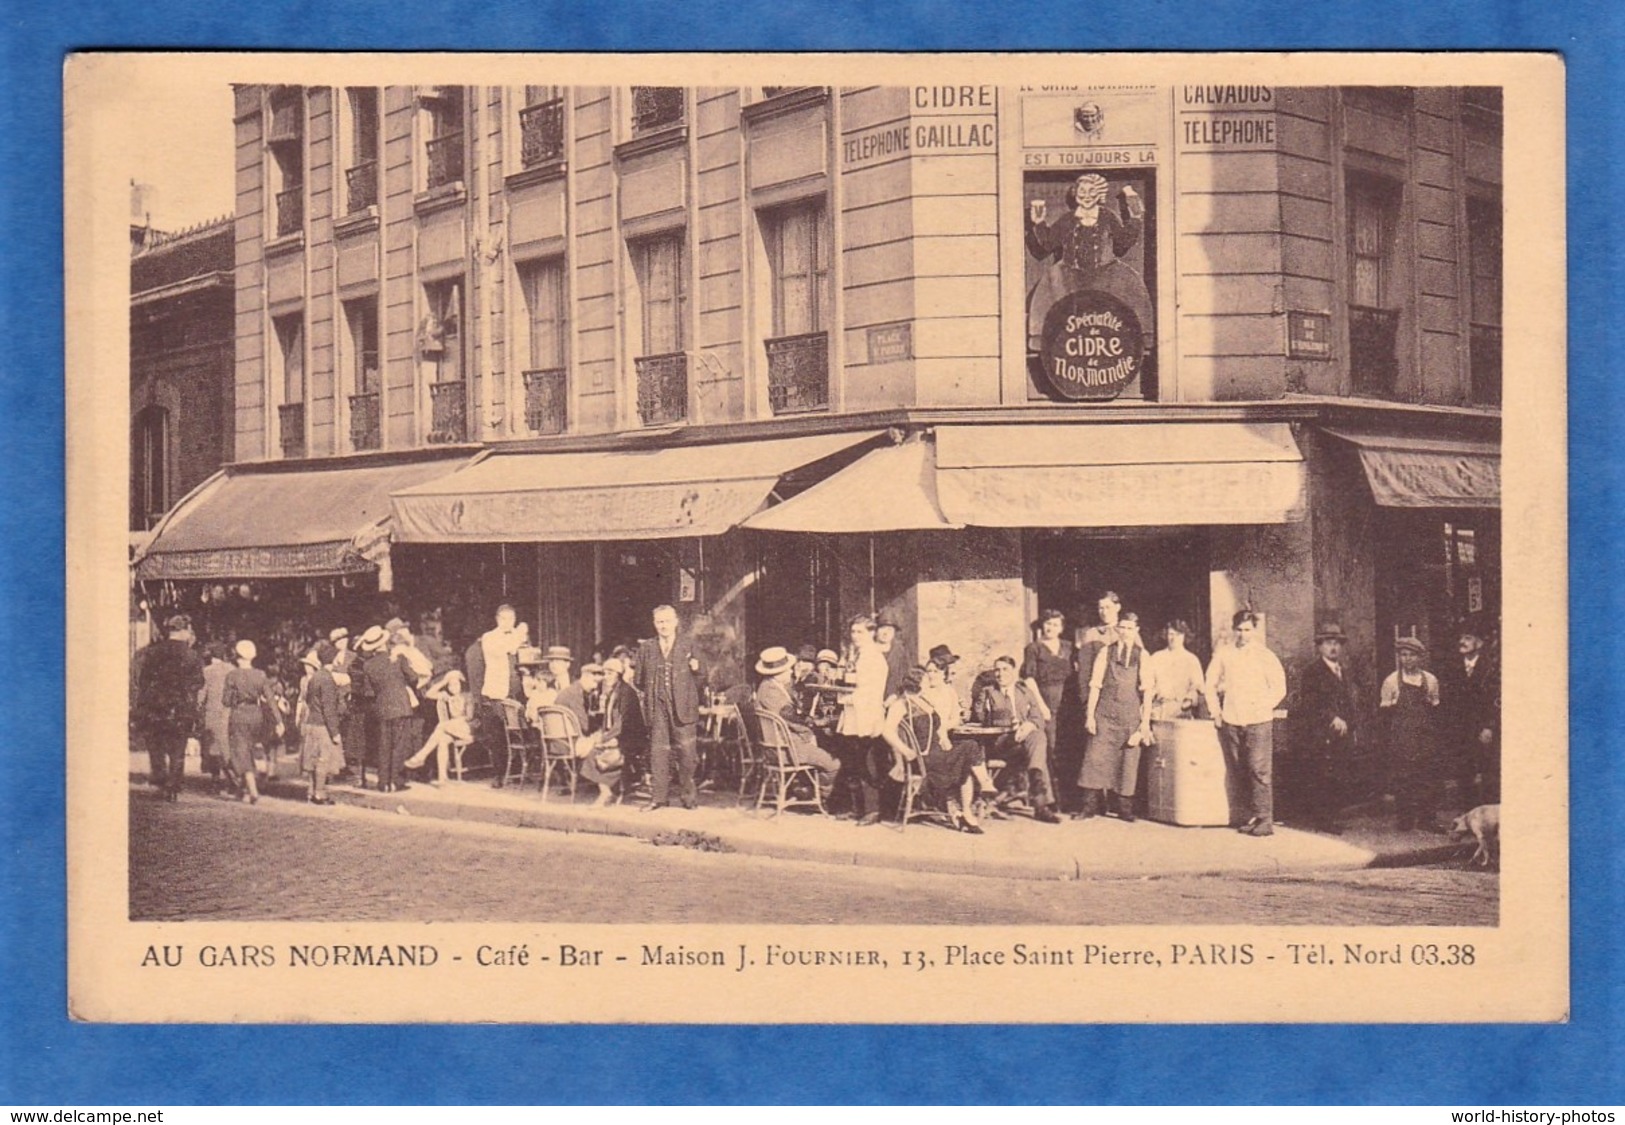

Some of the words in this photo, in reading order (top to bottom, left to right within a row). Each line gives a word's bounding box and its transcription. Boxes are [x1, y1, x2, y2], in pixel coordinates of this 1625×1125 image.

[914, 85, 992, 108] CIDRE
[842, 126, 910, 164] TELEPHONE
[915, 123, 994, 149] GAILLAC
[1024, 154, 1051, 166] EST
[1059, 152, 1132, 164] TOUJOURS
[1138, 151, 1156, 163] LA
[140, 944, 184, 968] AU
[198, 944, 276, 969] GARS
[289, 944, 439, 968] NORMAND
[476, 943, 530, 968] Café
[560, 944, 604, 968] Bar
[640, 943, 725, 967] Maison
[736, 944, 755, 973] J.
[944, 943, 1006, 967] Place
[1013, 943, 1074, 967] Saint
[1084, 943, 1162, 970] Pierre,
[1171, 943, 1254, 966] PARIS
[1286, 943, 1334, 967] Tél.
[1343, 943, 1402, 966] Nord
[1411, 943, 1476, 967] 03.38
